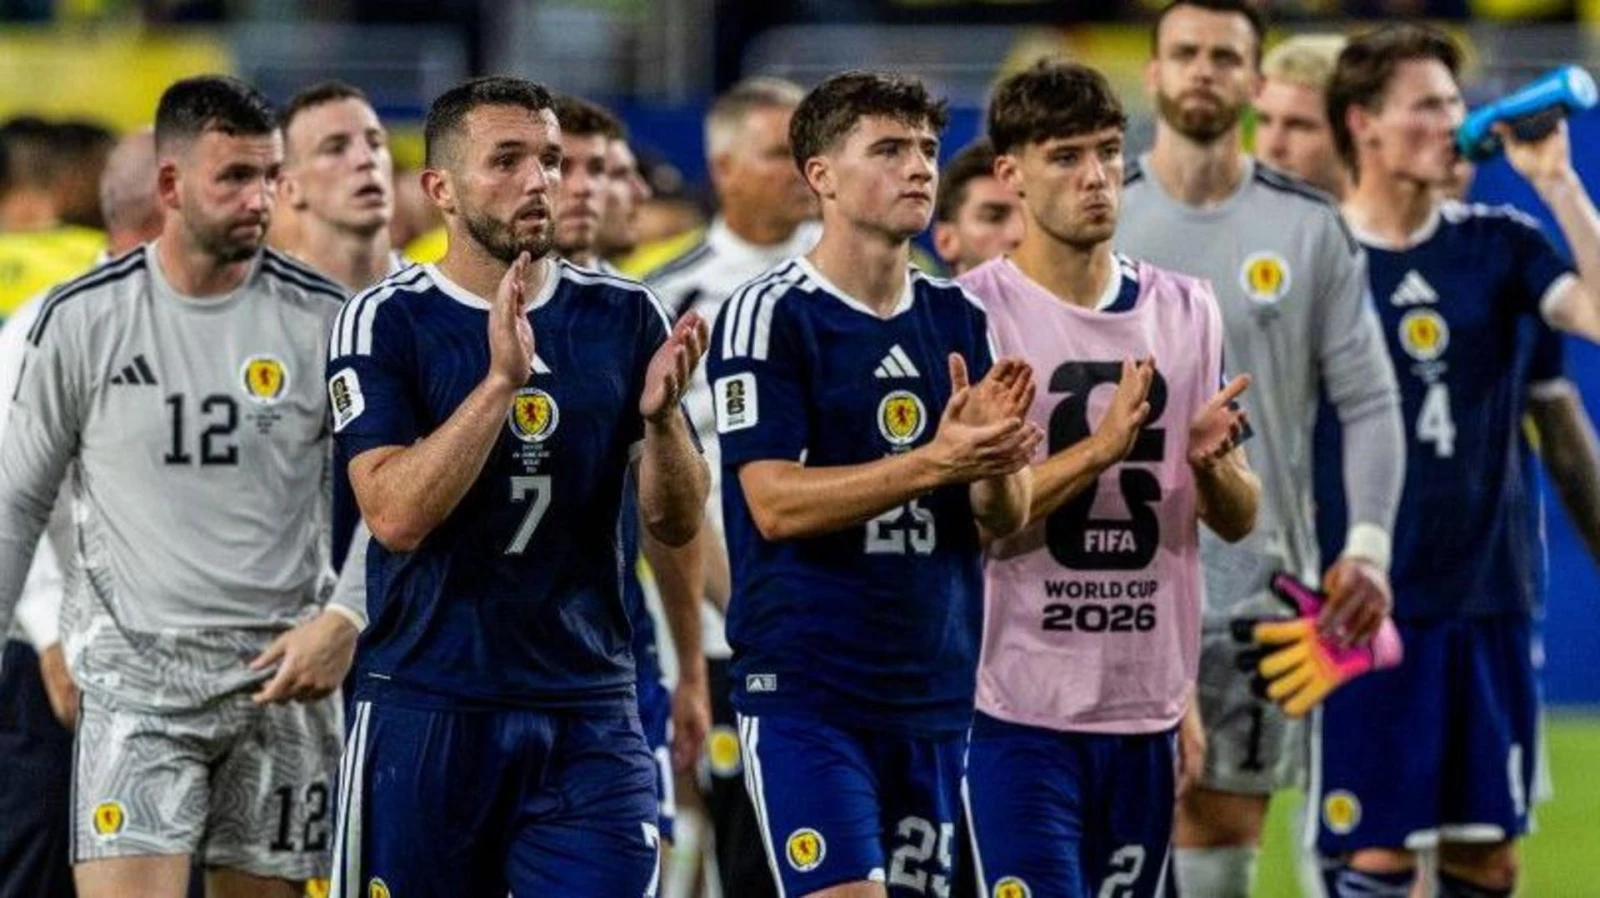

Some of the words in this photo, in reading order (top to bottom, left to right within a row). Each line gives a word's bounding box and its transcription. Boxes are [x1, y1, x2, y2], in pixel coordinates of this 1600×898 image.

[164, 394, 240, 466] 12
[1416, 383, 1456, 457] 4
[504, 475, 553, 555] 7
[1083, 530, 1136, 553] FIFA
[1041, 604, 1157, 633] 2026
[1044, 580, 1121, 600] WORLD
[1126, 580, 1158, 600] CUP
[1236, 702, 1264, 772] 1
[270, 783, 328, 852] 12
